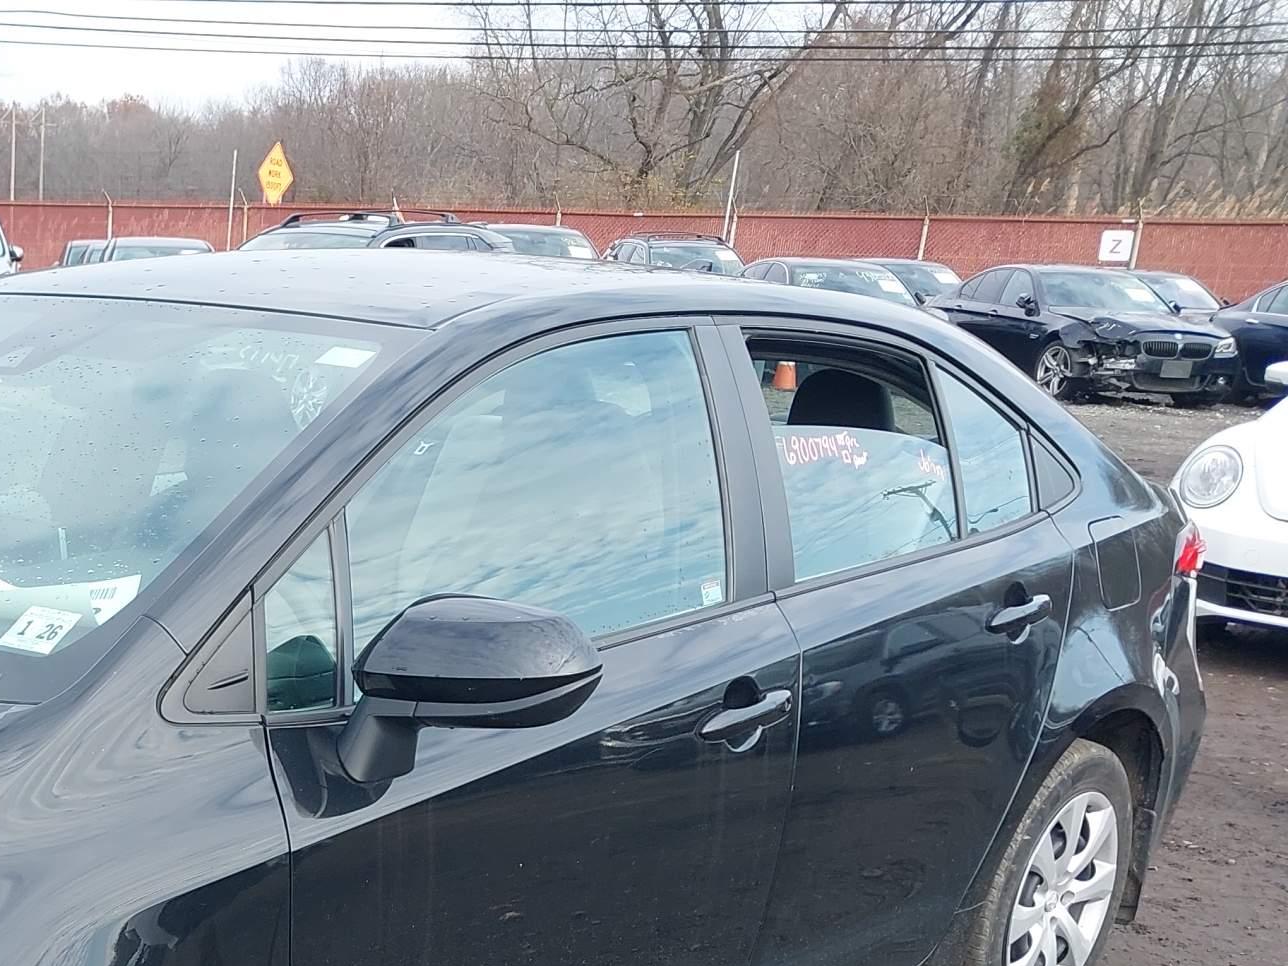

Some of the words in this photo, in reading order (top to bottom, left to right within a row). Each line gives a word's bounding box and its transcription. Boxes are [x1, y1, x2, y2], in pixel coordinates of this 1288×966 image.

[1109, 239, 1123, 254] Z
[16, 620, 34, 636] 1
[35, 623, 64, 641] 26
